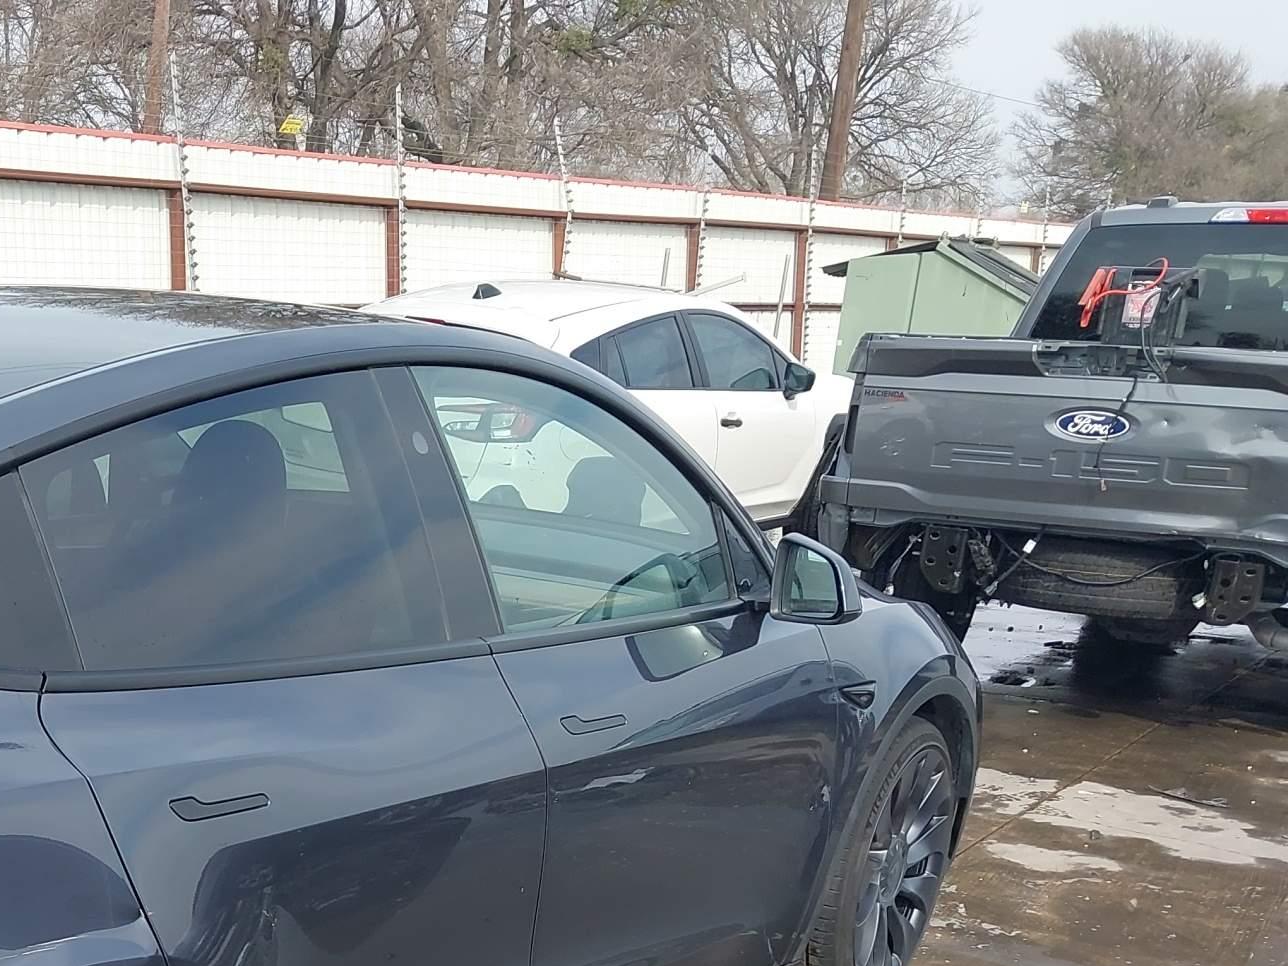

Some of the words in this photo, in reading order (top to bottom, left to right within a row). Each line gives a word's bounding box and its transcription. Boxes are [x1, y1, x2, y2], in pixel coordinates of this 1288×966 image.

[864, 389, 905, 398] HACIENDA
[1067, 414, 1116, 435] Ford
[930, 441, 1249, 490] F-150
